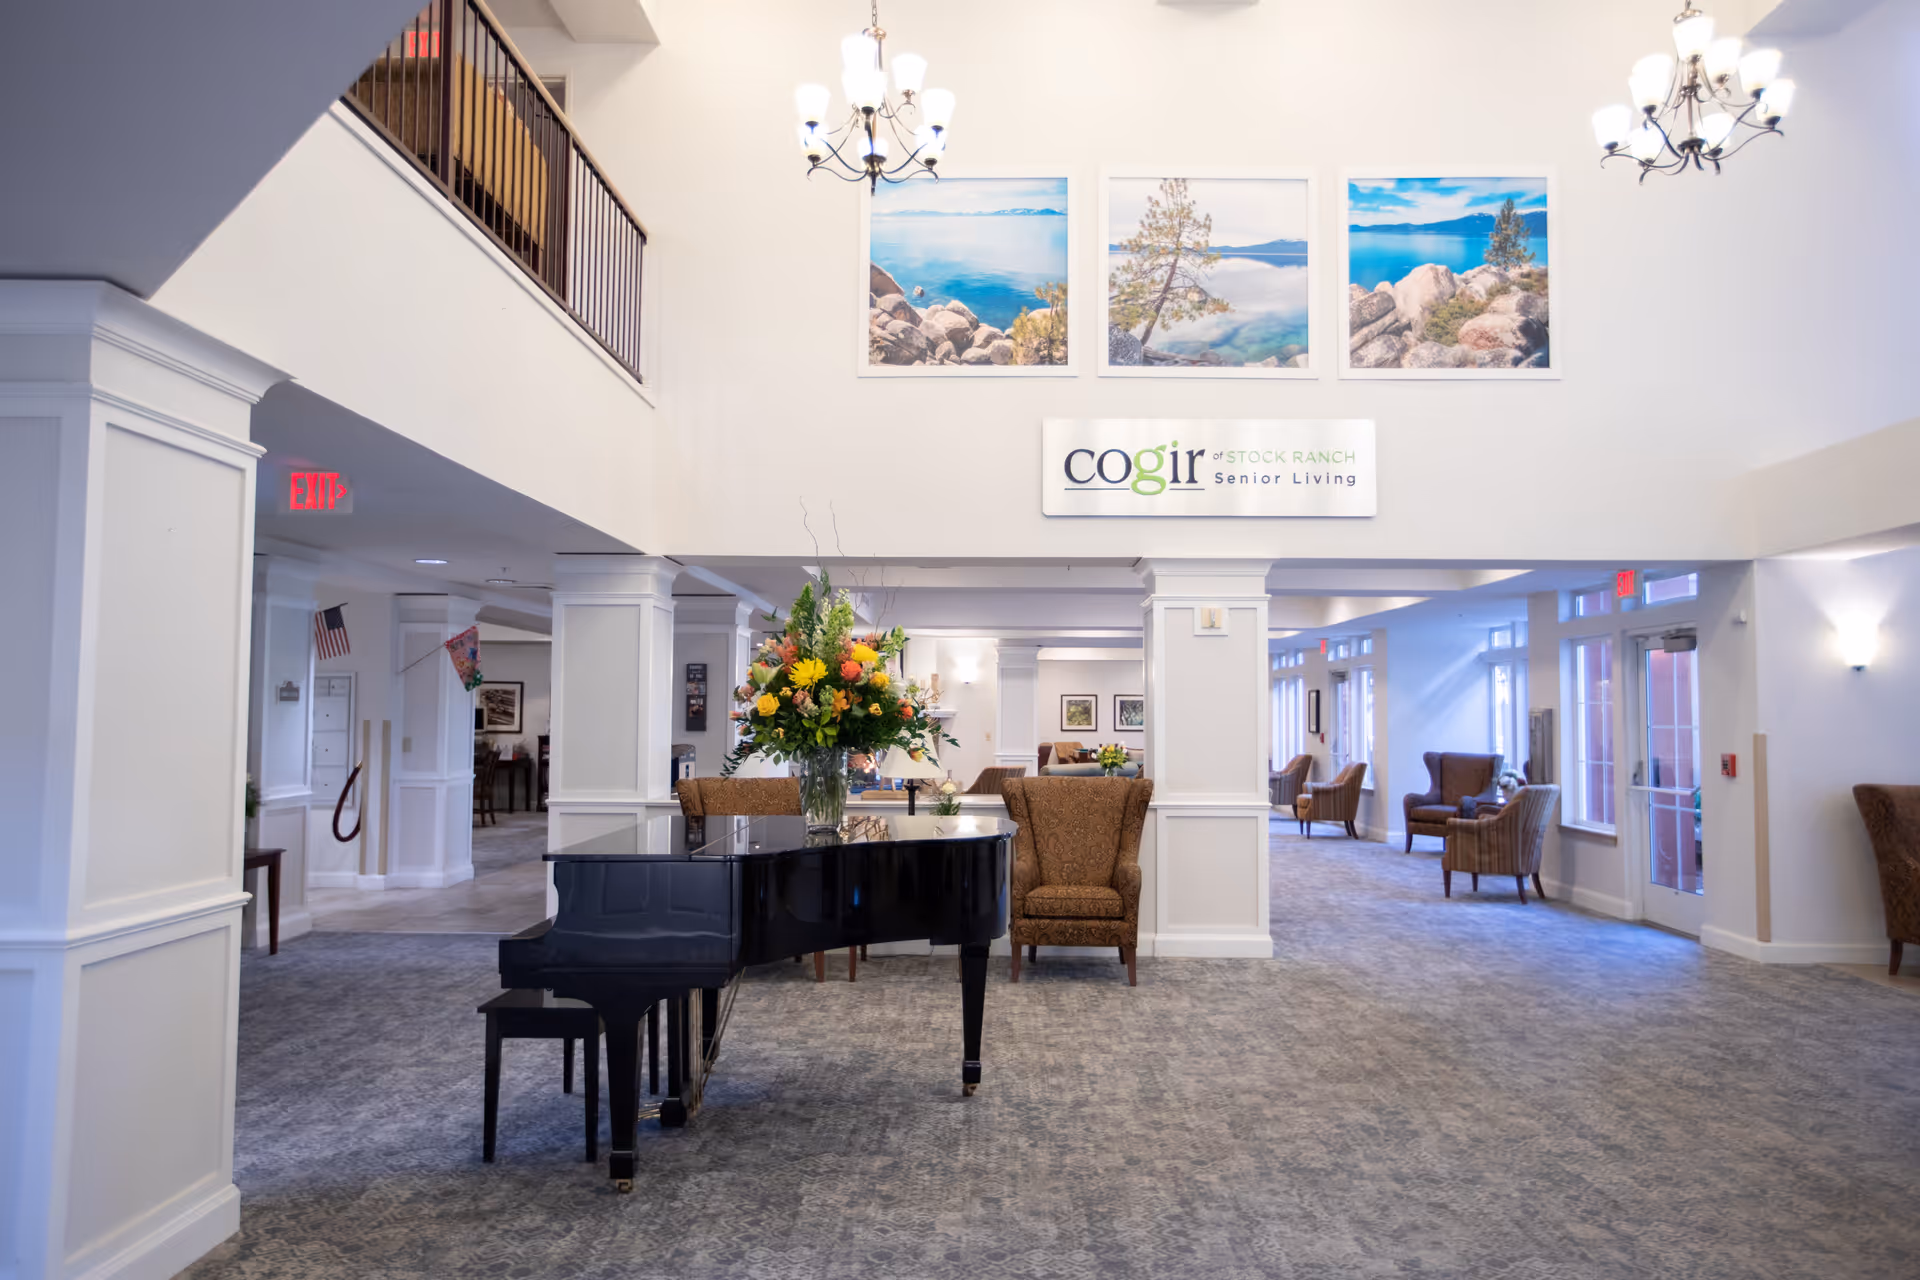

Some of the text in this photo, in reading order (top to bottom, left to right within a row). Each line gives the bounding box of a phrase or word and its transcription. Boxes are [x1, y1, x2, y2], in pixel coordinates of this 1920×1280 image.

[1064, 440, 1206, 495] cogir
[1212, 450, 1356, 464] of STOCK RANCH
[290, 472, 340, 510] EXIT
[1214, 472, 1356, 487] Senior Living
[1617, 570, 1635, 597] EXIT
